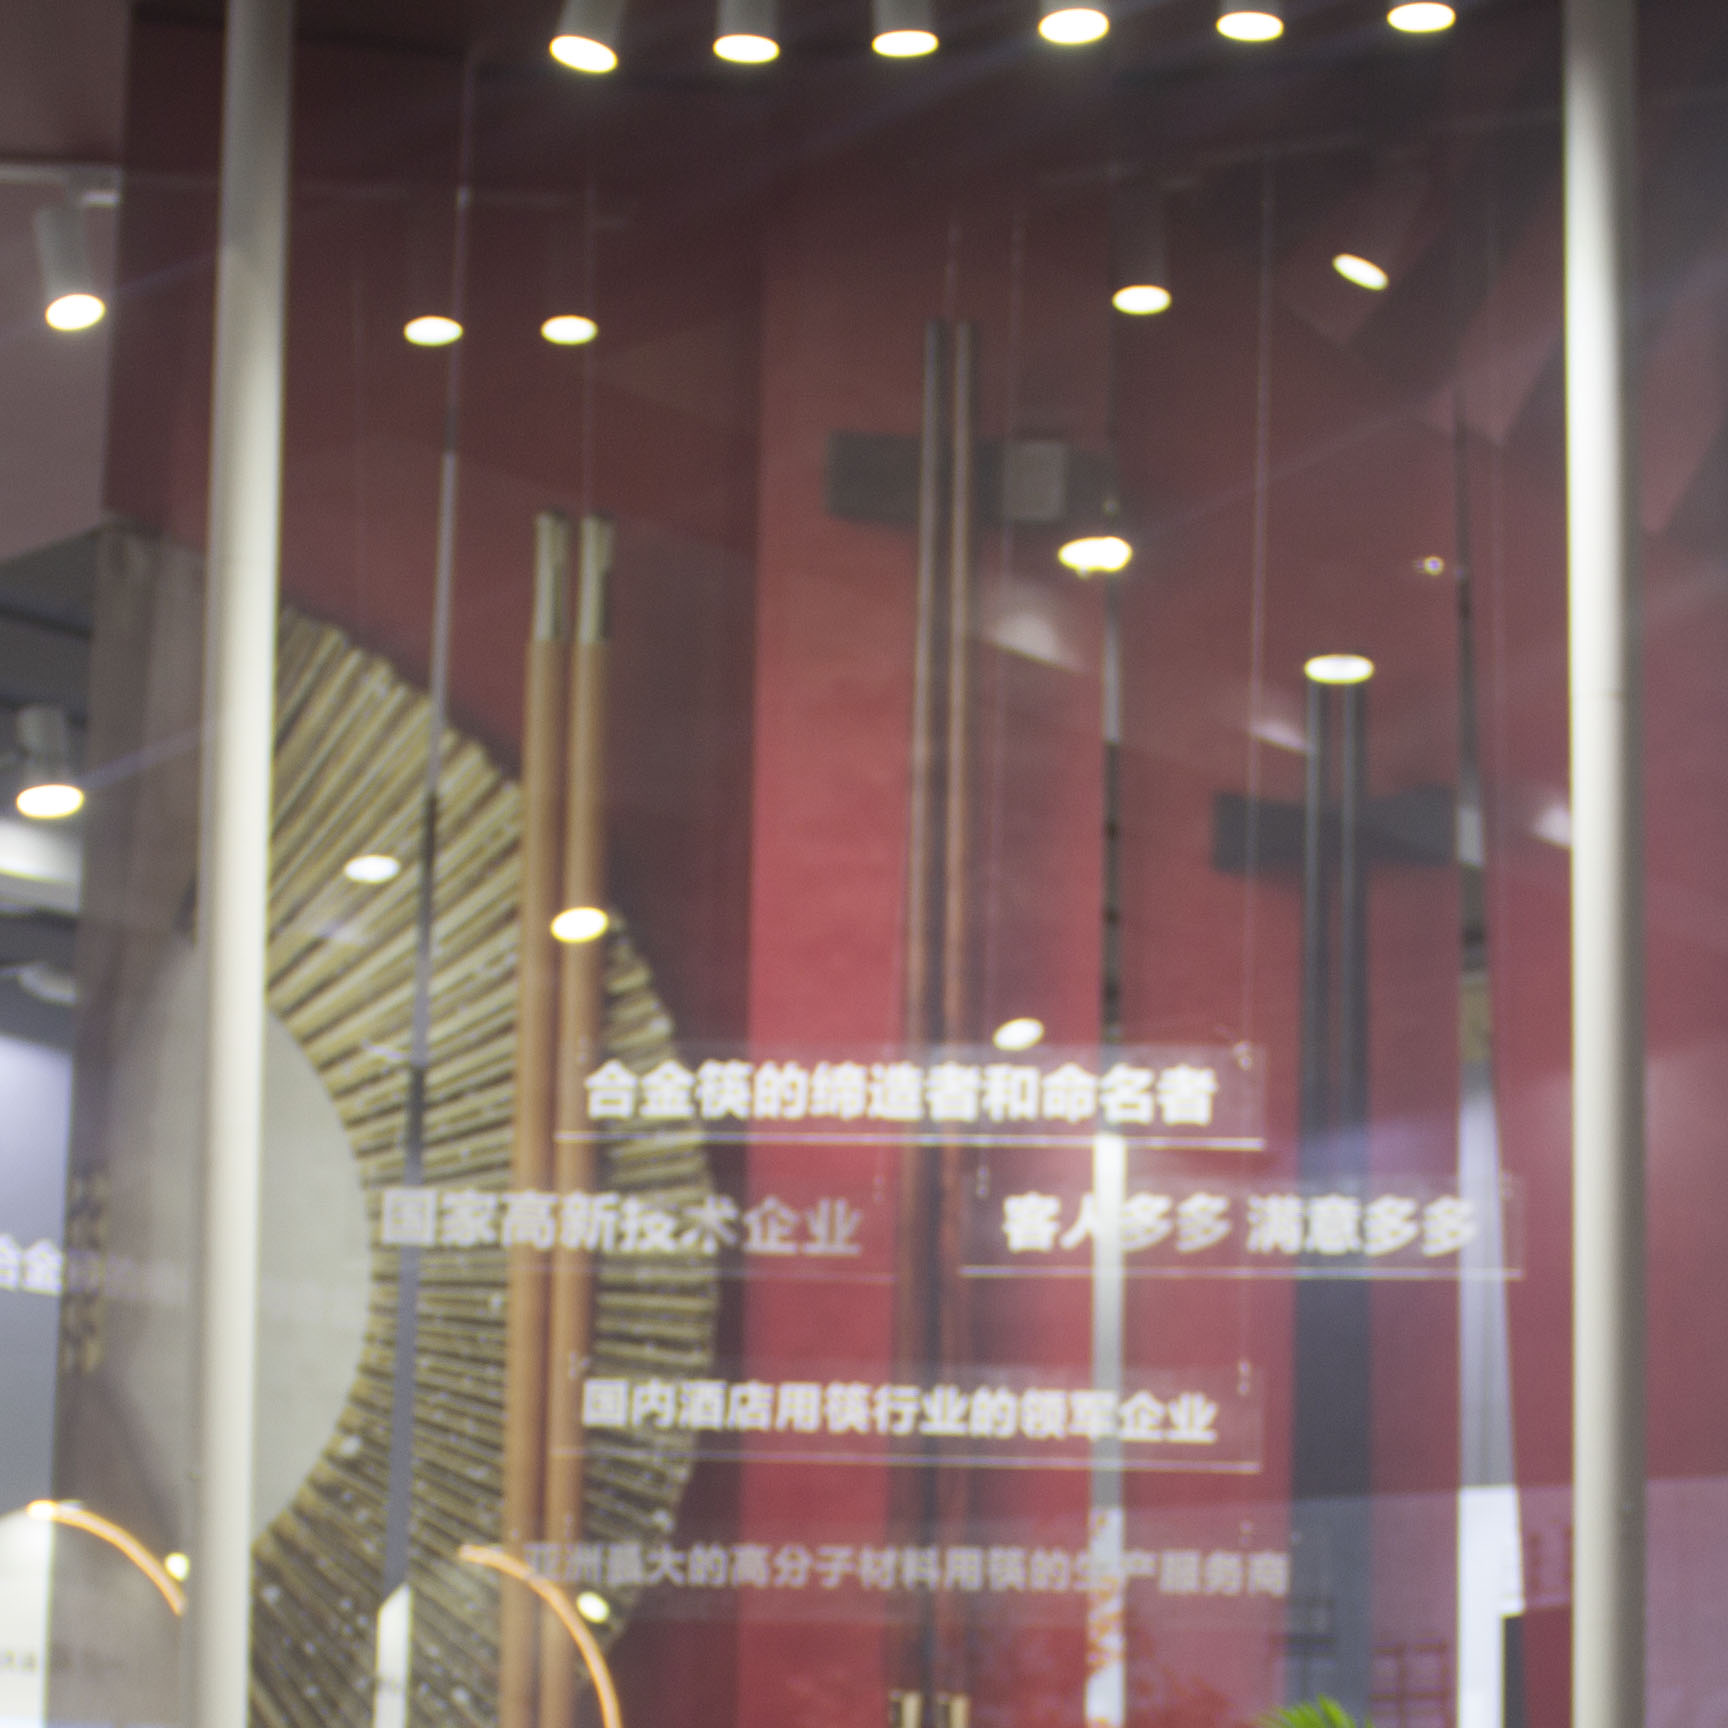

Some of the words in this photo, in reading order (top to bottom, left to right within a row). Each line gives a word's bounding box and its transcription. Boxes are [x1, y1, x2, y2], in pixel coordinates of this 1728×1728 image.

[585, 1059, 1218, 1127] 合金筷的缔造者和命名者
[380, 1187, 863, 1257] 国家高新技术企业
[581, 1378, 1219, 1445] 国内酒店用筷行业的领军企业
